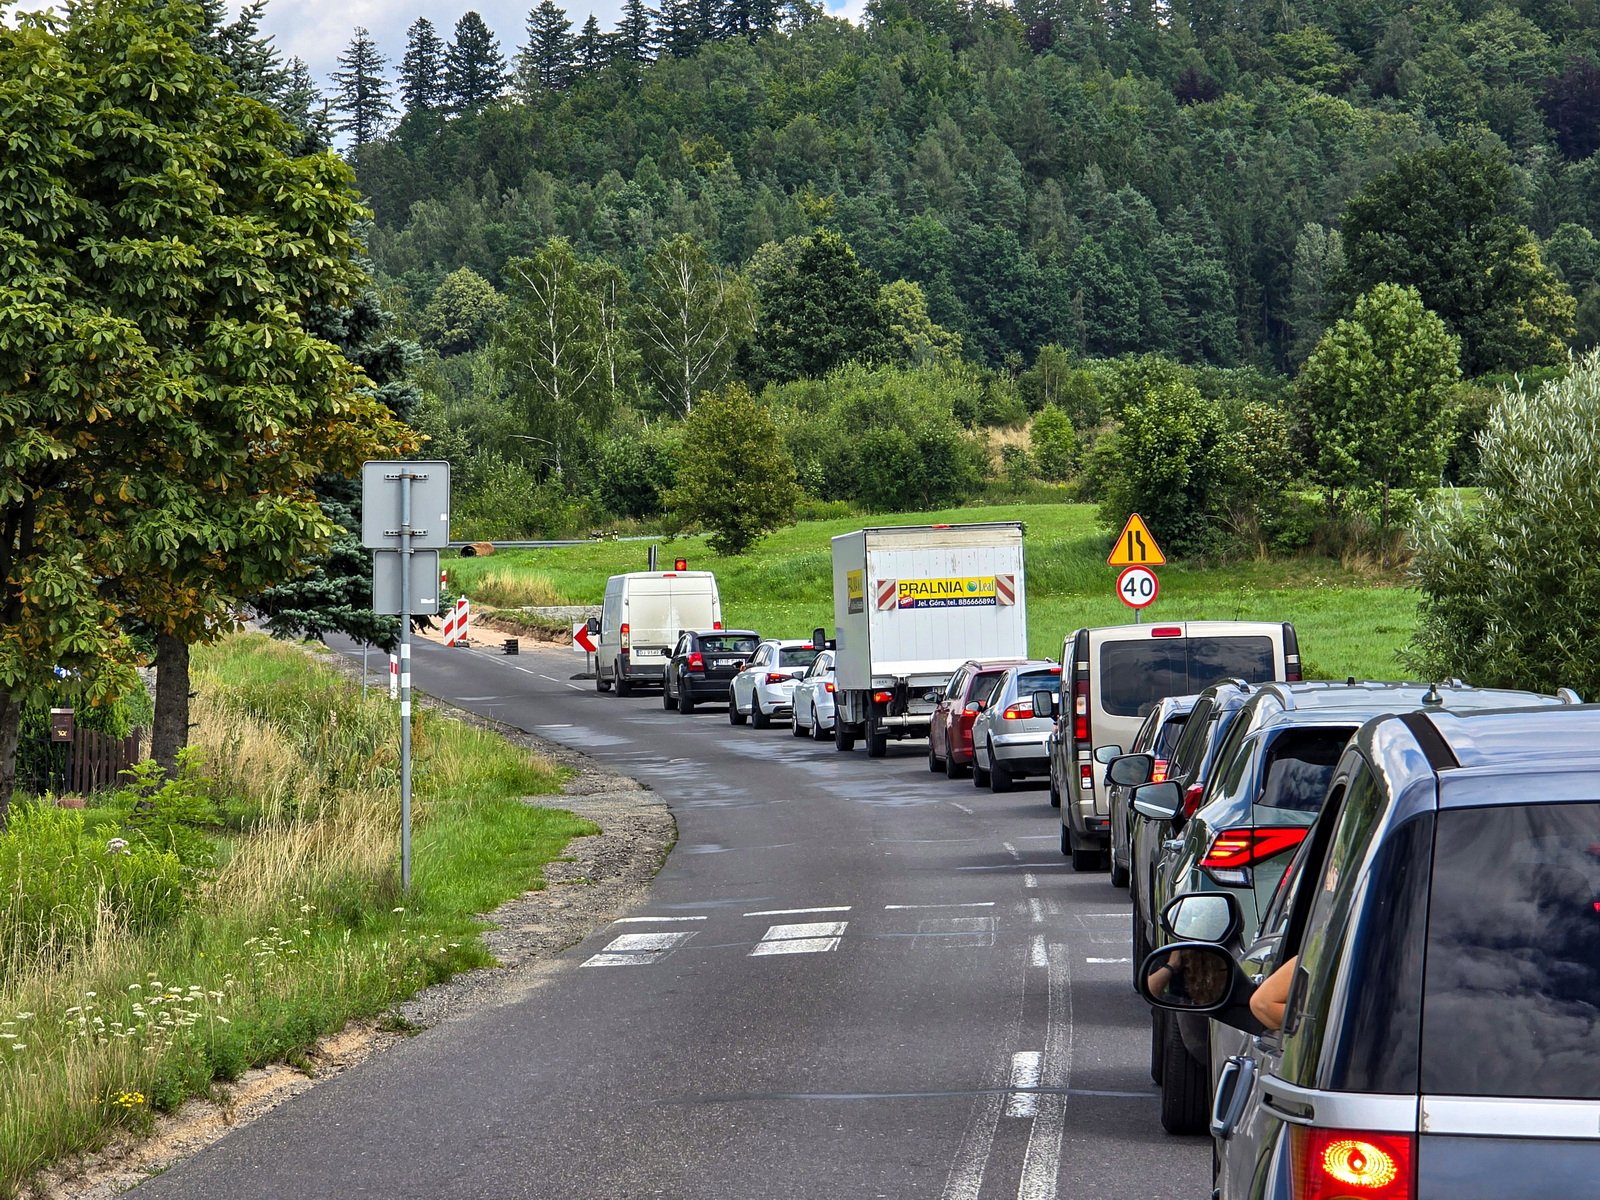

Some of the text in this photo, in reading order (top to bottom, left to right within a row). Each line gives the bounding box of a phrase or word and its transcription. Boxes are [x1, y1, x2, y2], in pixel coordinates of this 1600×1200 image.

[899, 581, 963, 594] PRALNIA
[1123, 577, 1153, 597] 40
[947, 598, 957, 606] tel.
